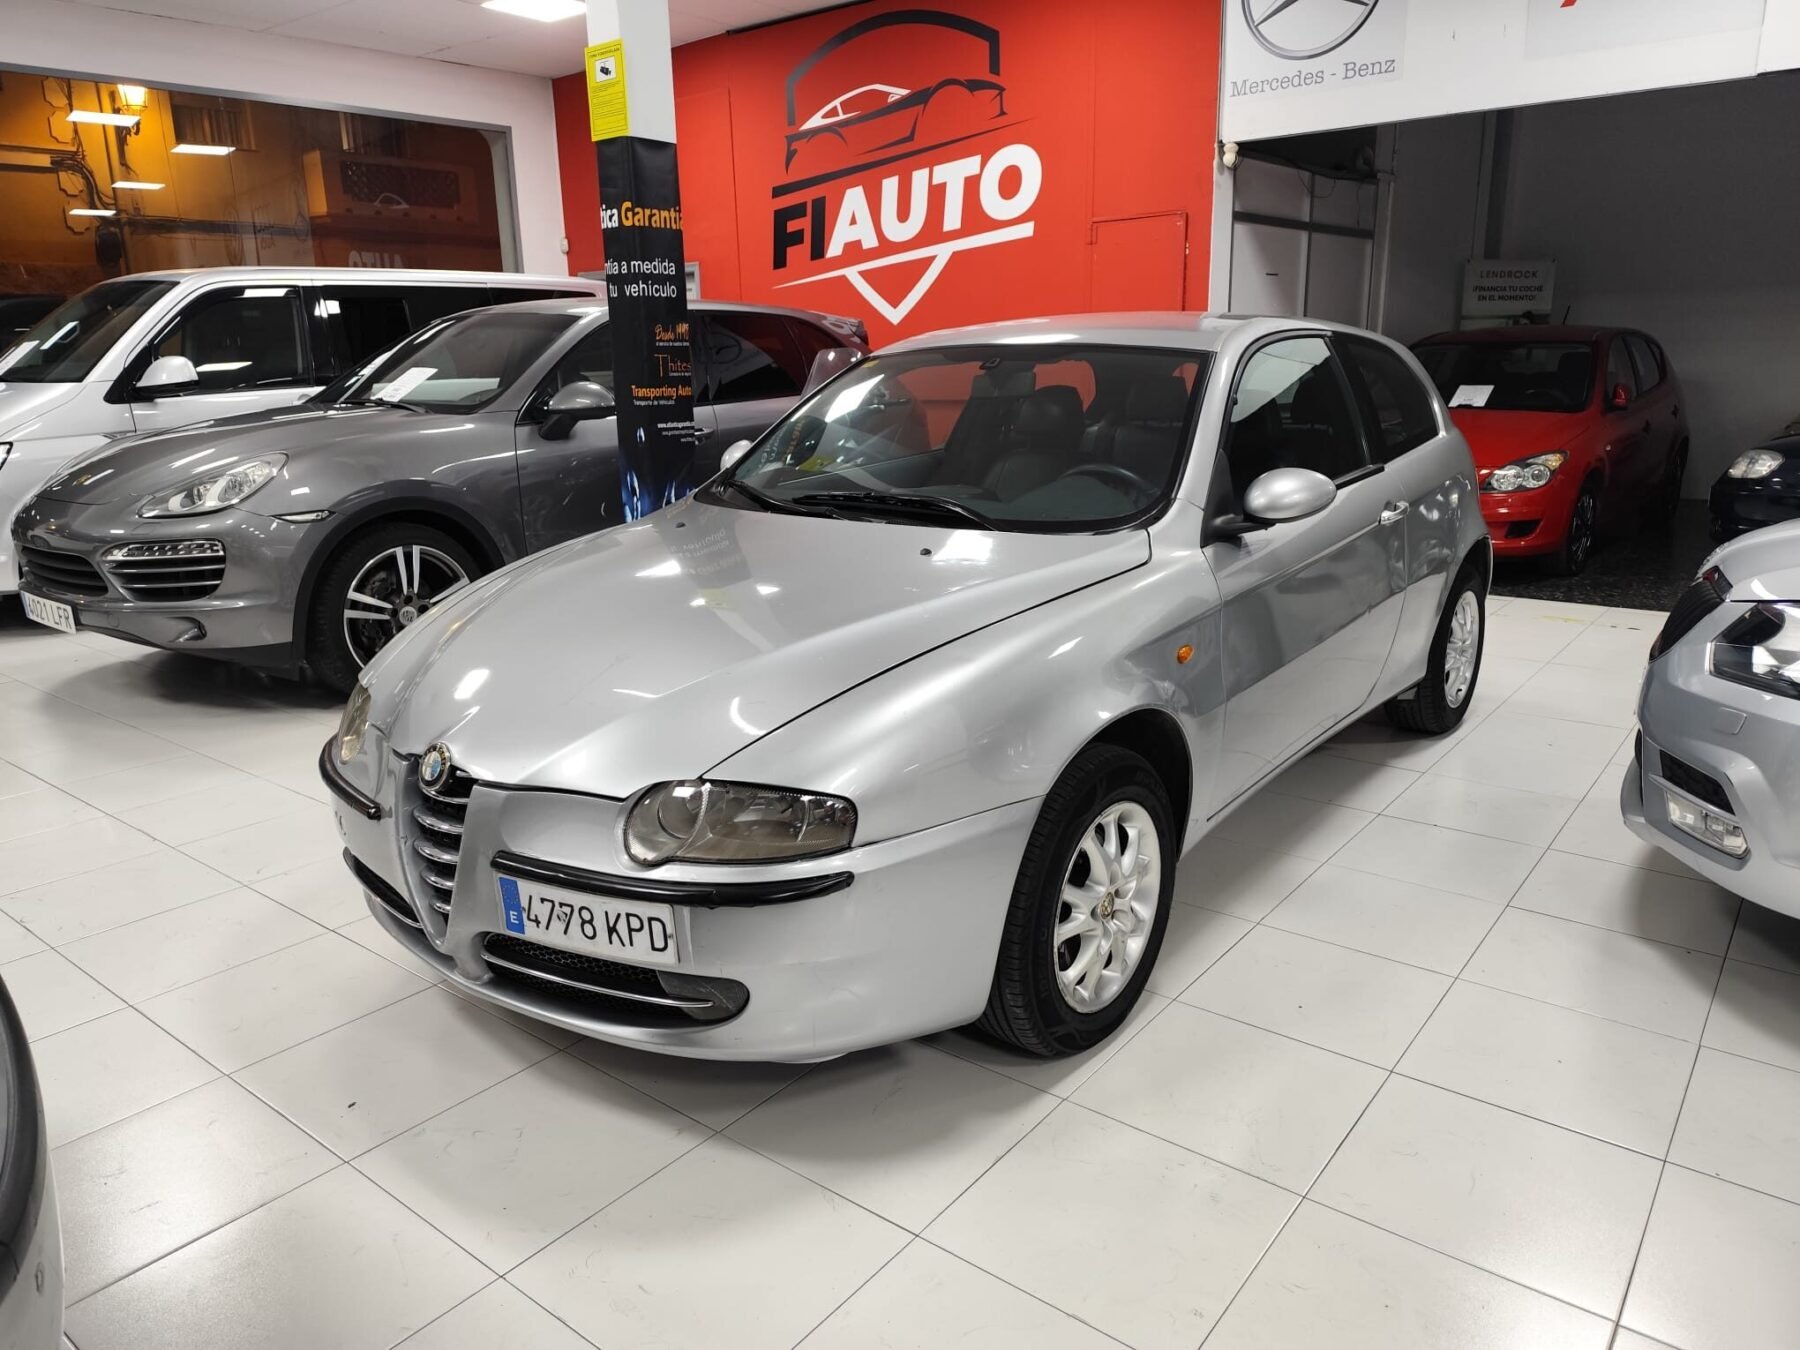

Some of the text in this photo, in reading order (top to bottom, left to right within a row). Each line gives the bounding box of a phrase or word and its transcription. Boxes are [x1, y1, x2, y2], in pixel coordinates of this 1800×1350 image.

[1229, 69, 1324, 97] Mercedes
[1341, 59, 1396, 80] Benz
[773, 144, 1042, 270] FIAUTO
[621, 261, 628, 274] a
[630, 258, 676, 275] medida
[1480, 270, 1538, 279] LENDROCK
[609, 280, 677, 298] tu vehículo
[1477, 294, 1487, 302] EN
[631, 384, 677, 400] Transporting
[50, 604, 72, 630] LFR
[509, 911, 519, 924] E
[526, 895, 669, 952] 4778 KPD
